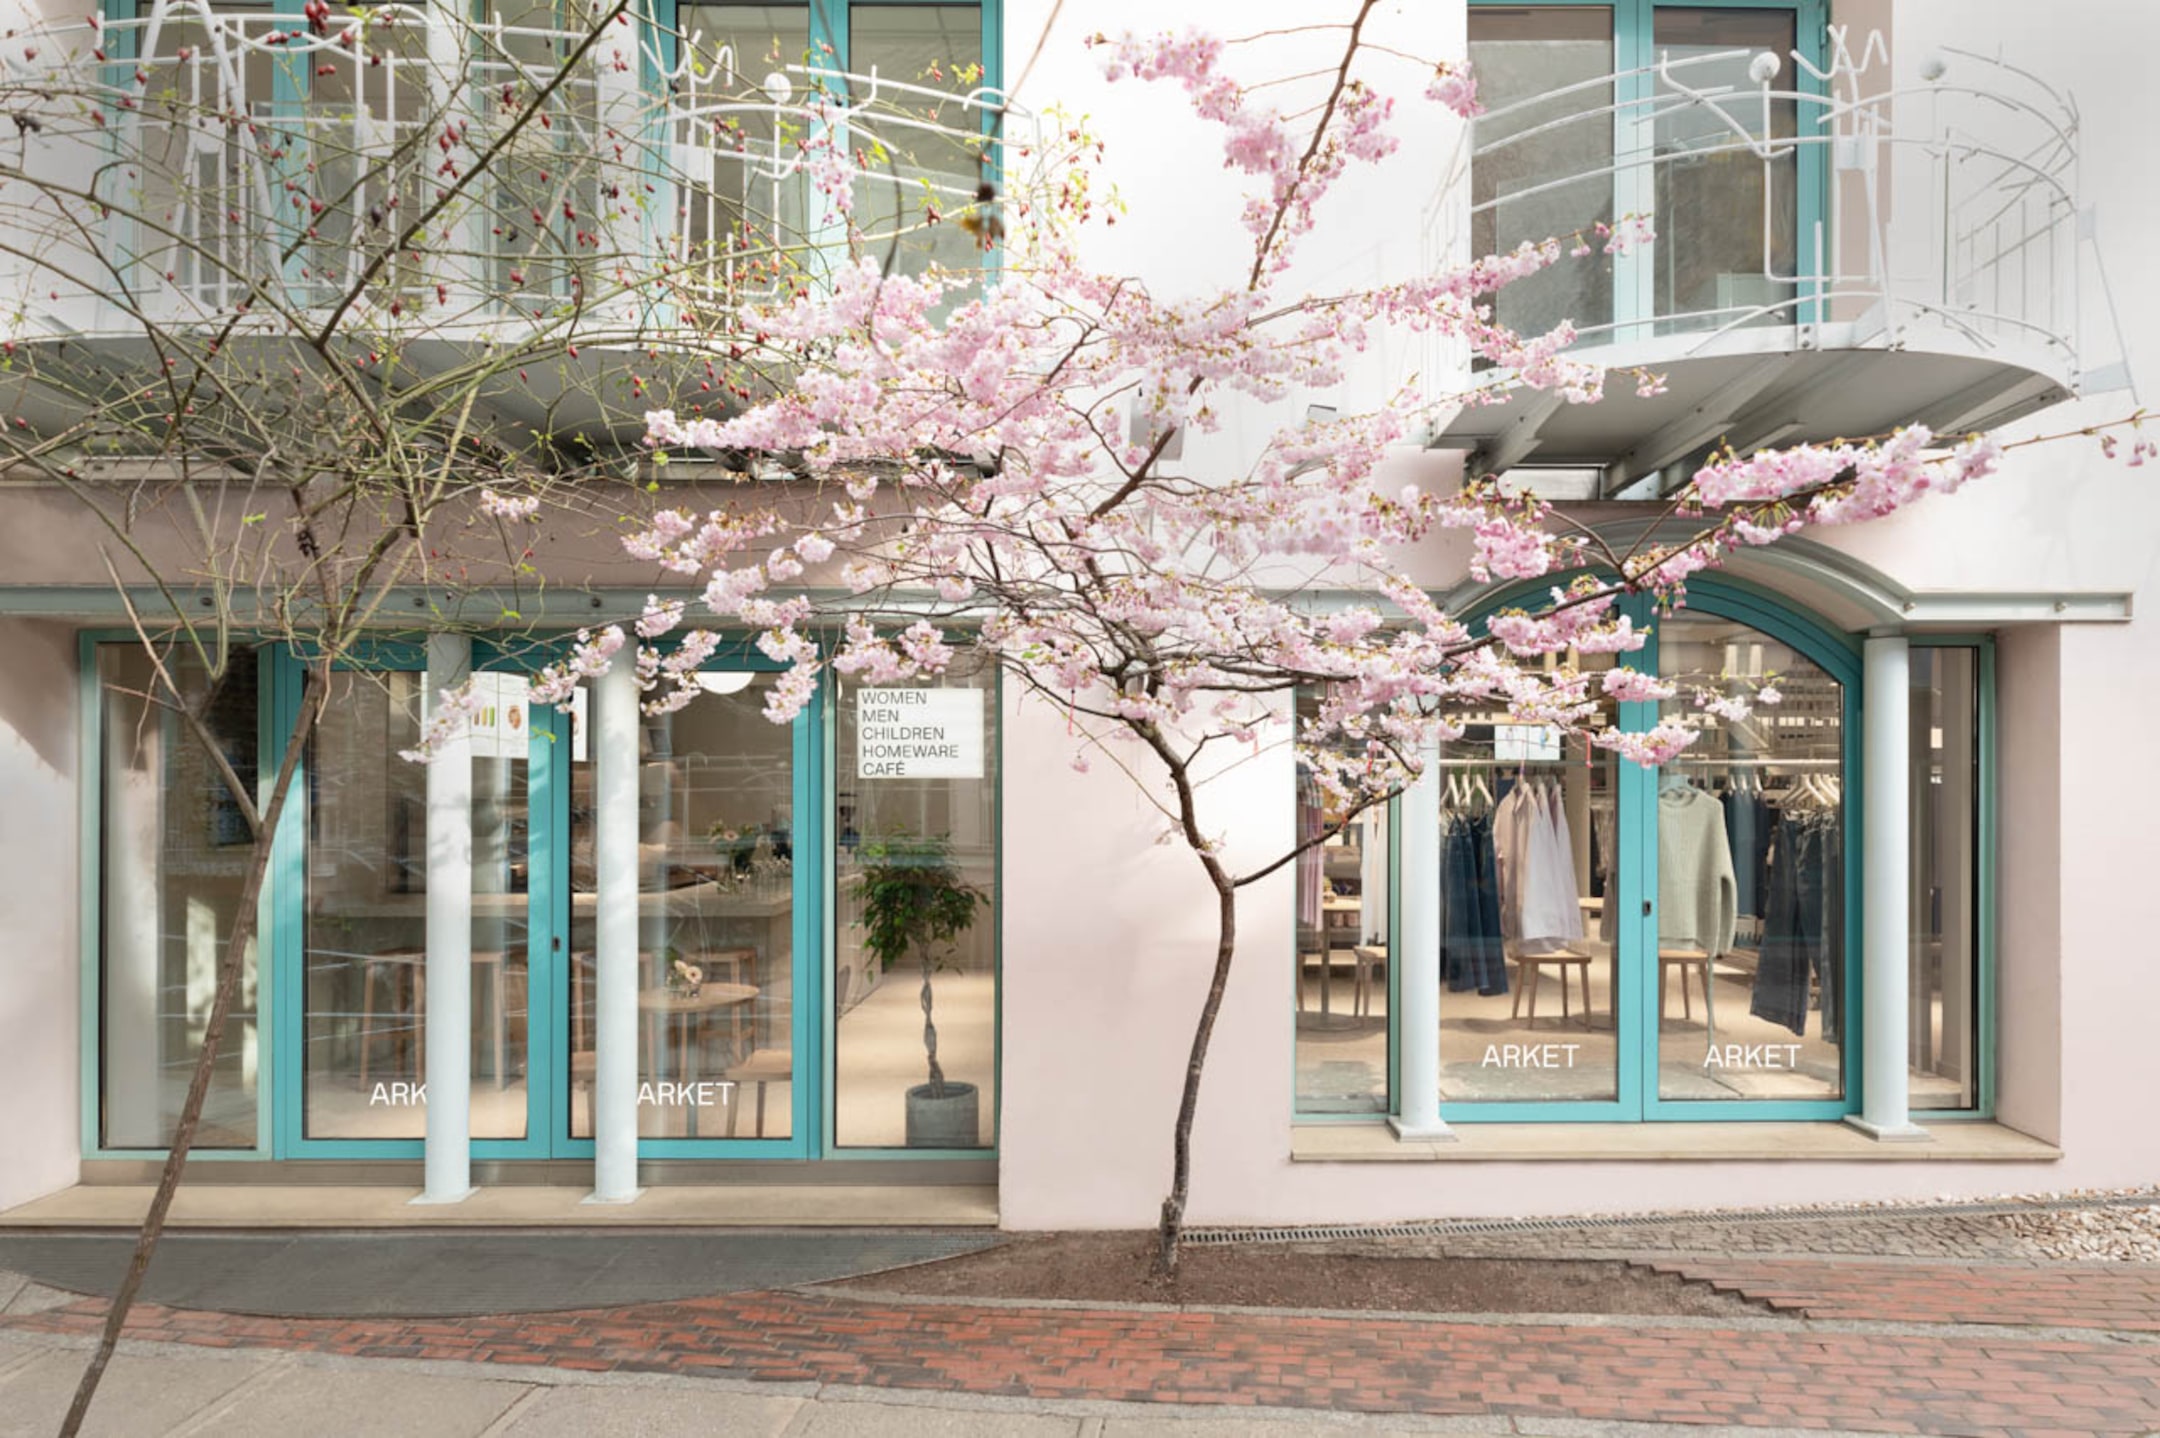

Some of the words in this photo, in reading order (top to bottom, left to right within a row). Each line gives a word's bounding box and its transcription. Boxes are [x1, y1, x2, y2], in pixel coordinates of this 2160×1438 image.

[861, 691, 927, 705] WOMEN
[862, 709, 899, 722] MEN
[862, 727, 945, 740] CHILDREN
[862, 744, 959, 759] HOMEWARE
[863, 761, 905, 776] CAFÉ
[1482, 1044, 1580, 1068] ARKET
[1703, 1044, 1802, 1068] ARKET
[637, 1082, 735, 1106] ARKET
